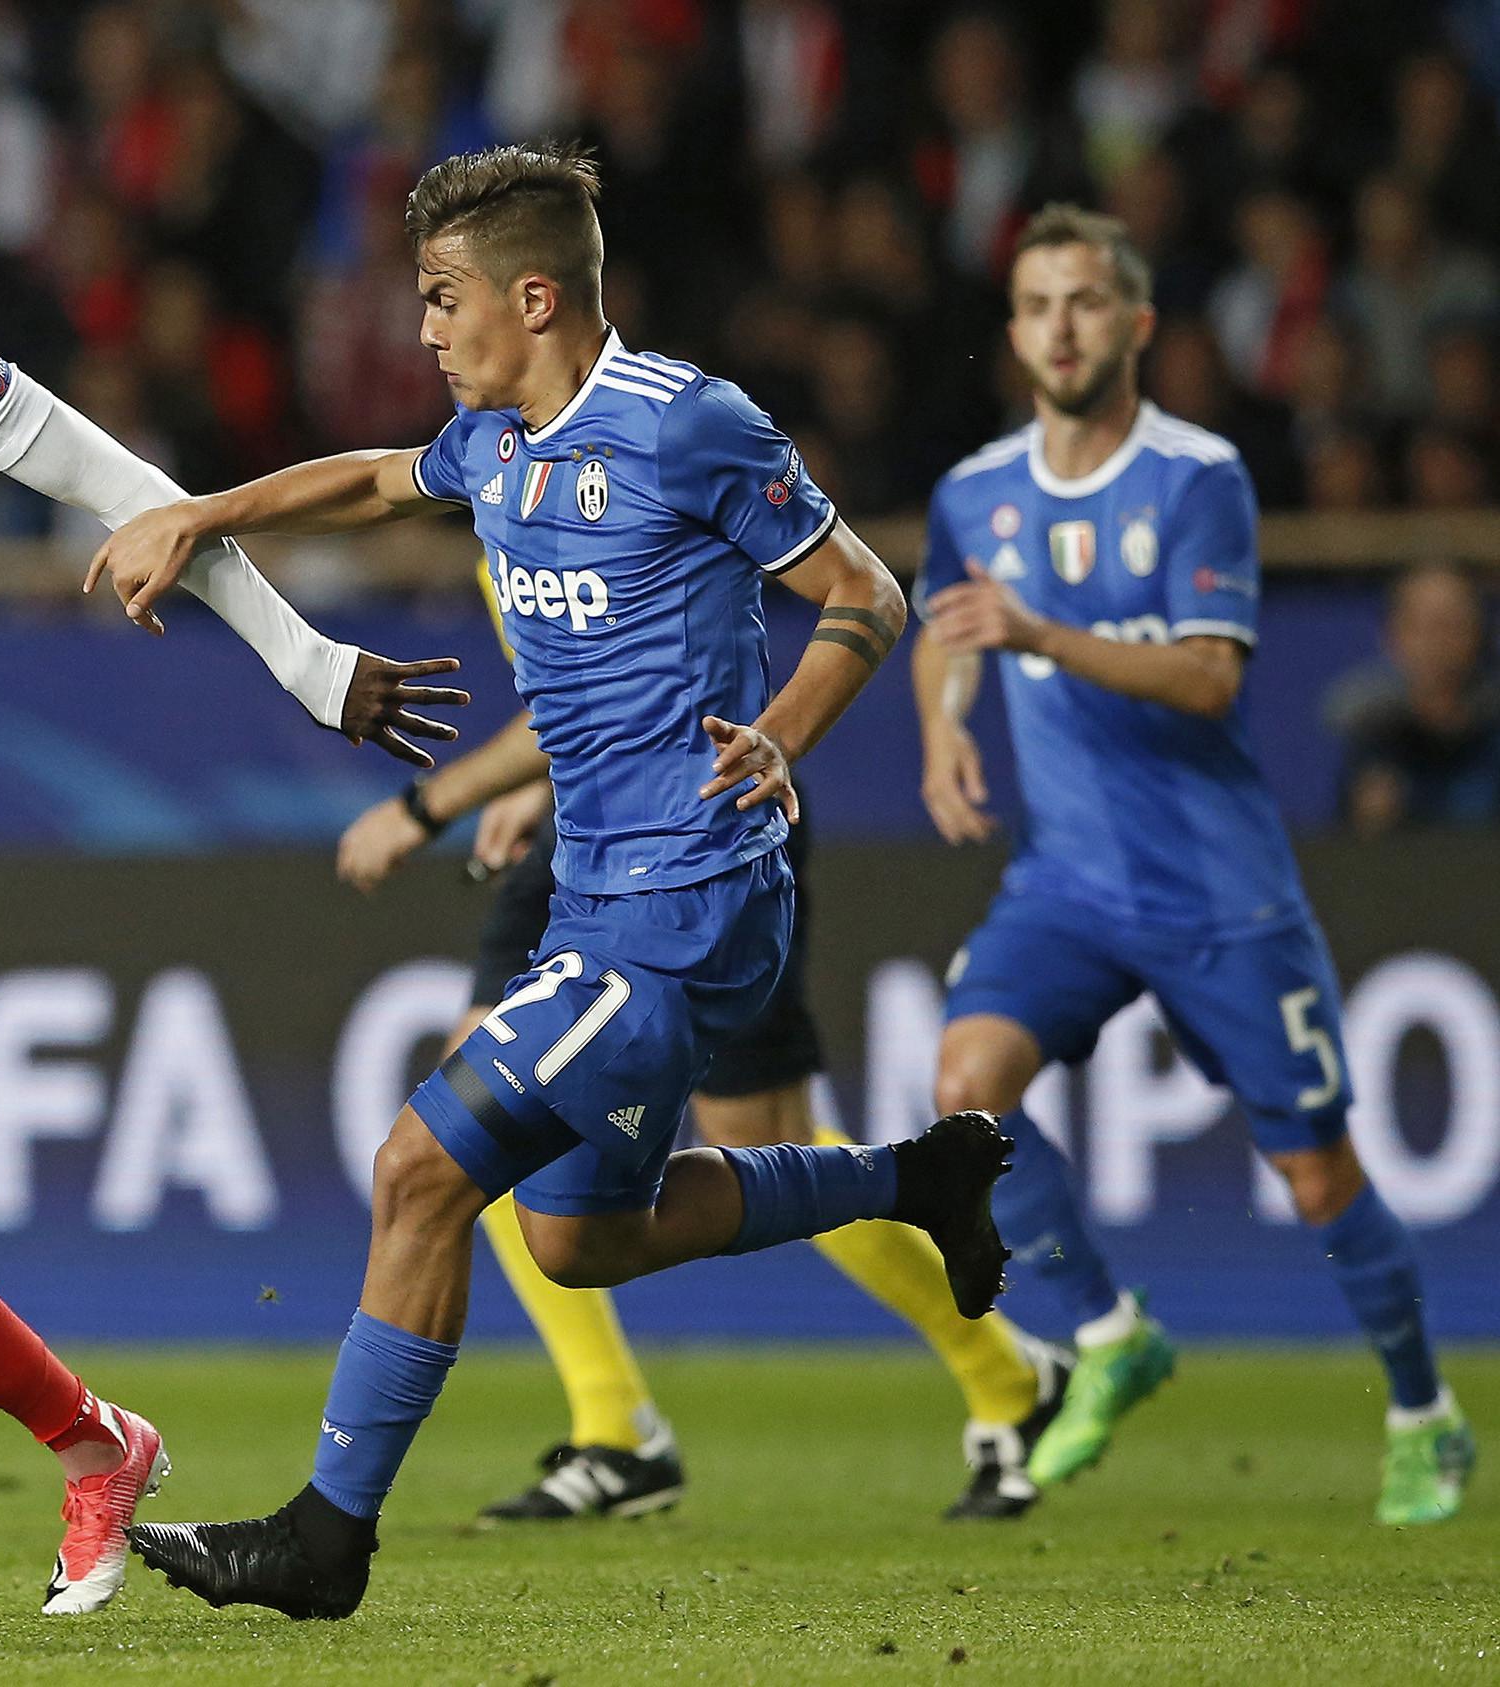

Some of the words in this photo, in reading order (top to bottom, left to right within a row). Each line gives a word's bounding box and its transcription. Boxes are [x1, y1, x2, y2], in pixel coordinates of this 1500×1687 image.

[492, 548, 609, 632] Jeep
[480, 950, 631, 1086] 21
[1277, 987, 1342, 1112] 5
[607, 1112, 639, 1140] adidas
